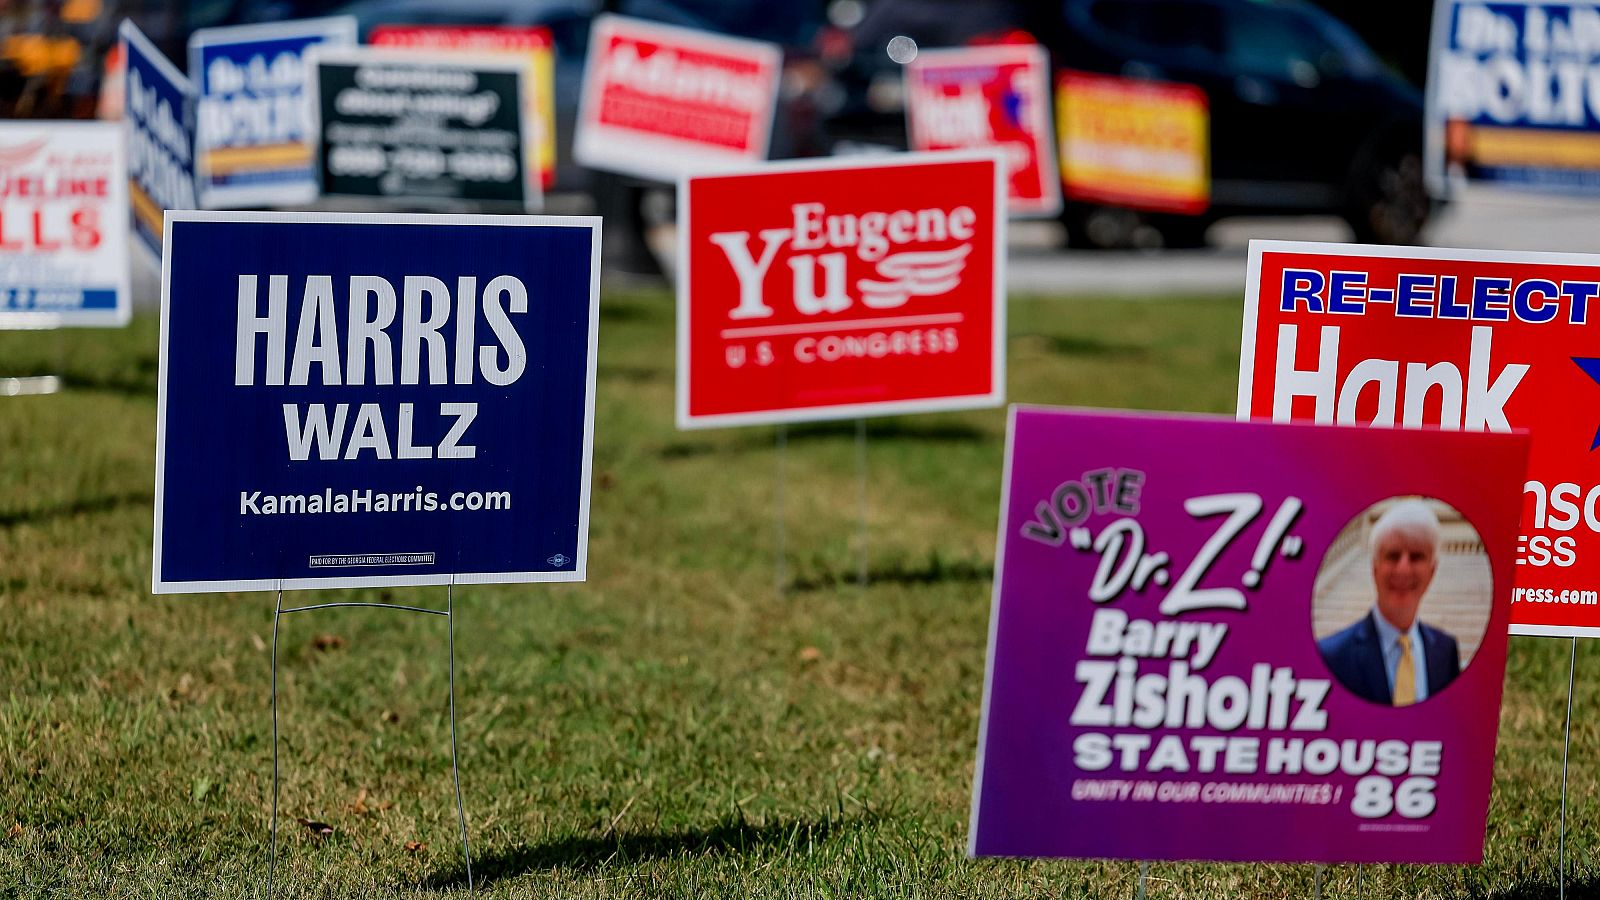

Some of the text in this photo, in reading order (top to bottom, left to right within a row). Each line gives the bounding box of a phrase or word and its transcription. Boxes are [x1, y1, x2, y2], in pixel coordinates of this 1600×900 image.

[790, 202, 977, 262] Eugene
[709, 228, 853, 320] Yu
[1279, 268, 1600, 325] RE-ELECT
[235, 274, 528, 386] HARRIS
[794, 327, 959, 363] CONGRESS
[1272, 324, 1530, 433] Hank
[283, 402, 478, 460] WALZ
[240, 486, 511, 514] KamalaHarris.com
[1021, 467, 1146, 548] VOTE
[1085, 607, 1229, 670] Barry
[1069, 656, 1332, 732] Zisholtz
[1072, 732, 1443, 777] STATE HOUSE
[1071, 778, 1134, 801] UNITY
[1132, 780, 1158, 801] IN
[1157, 780, 1201, 803] OUR
[1350, 775, 1438, 819] 86
